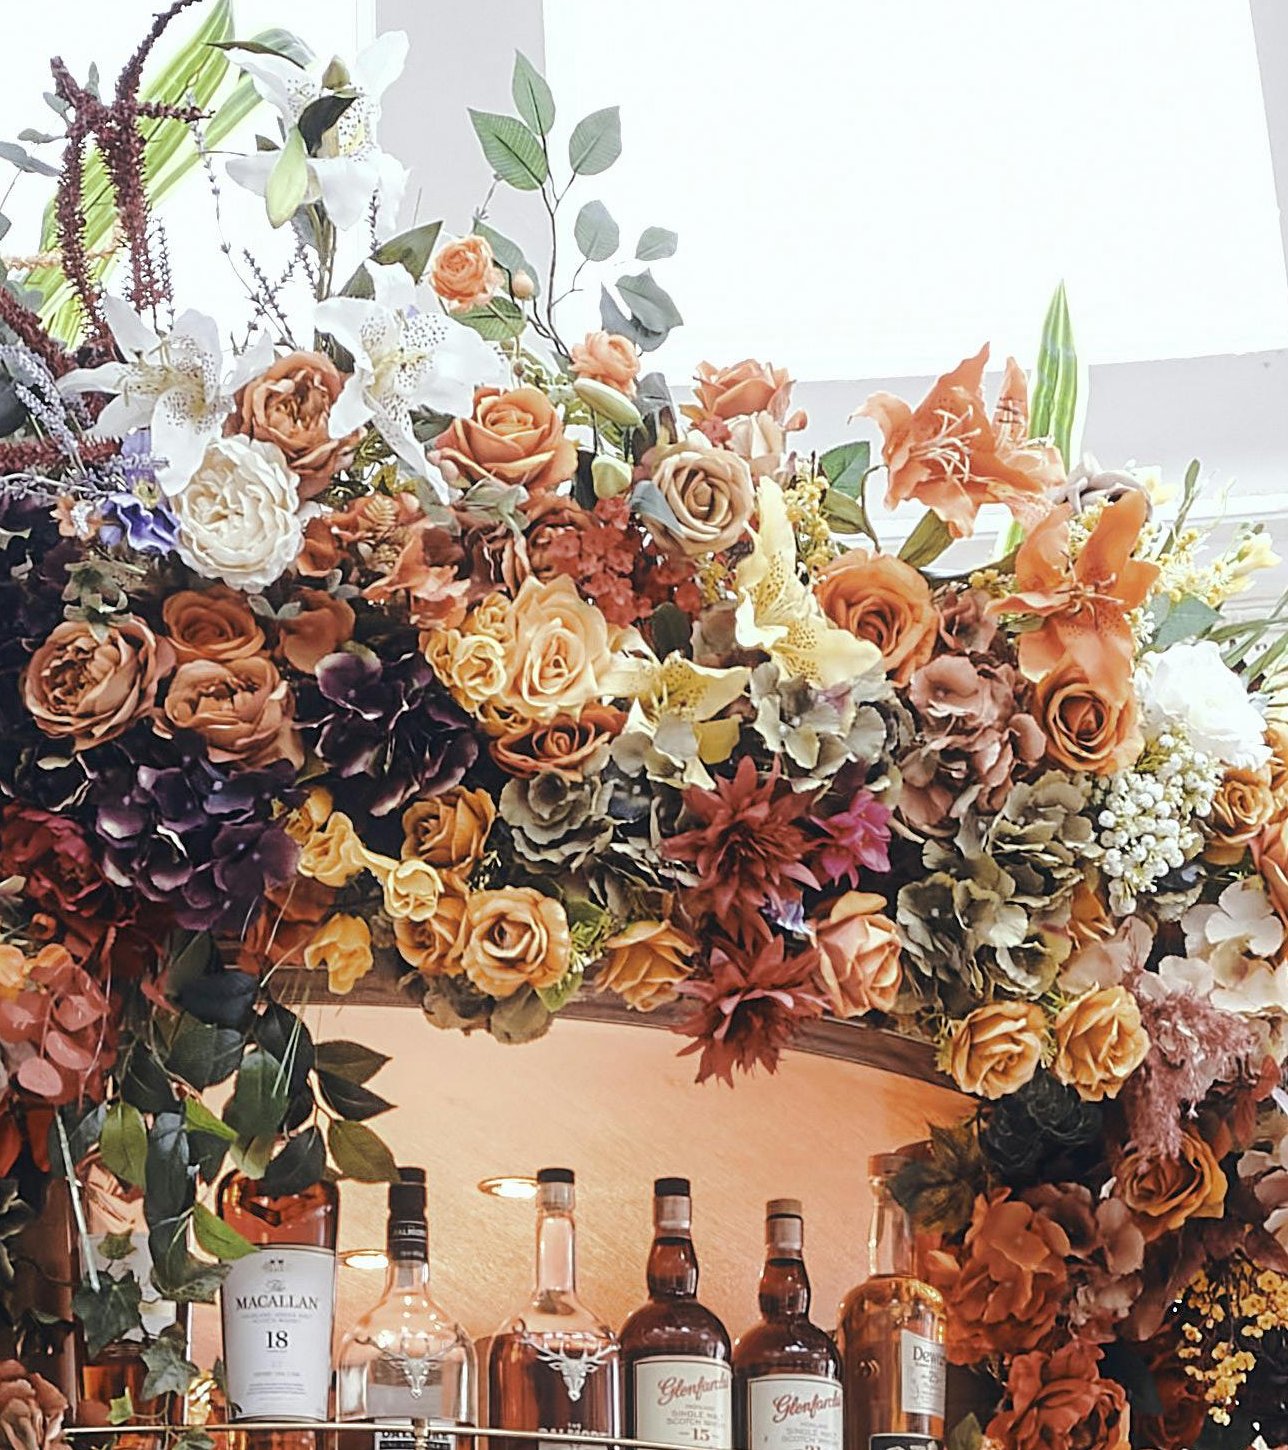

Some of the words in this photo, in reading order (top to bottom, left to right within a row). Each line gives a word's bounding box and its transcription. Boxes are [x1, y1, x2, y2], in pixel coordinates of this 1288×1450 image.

[235, 1294, 319, 1311] MACALLAN
[265, 1330, 289, 1349] 18
[657, 1370, 729, 1406] Glenfarcla
[772, 1389, 841, 1424] Glenfarcla
[693, 1427, 711, 1442] 15
